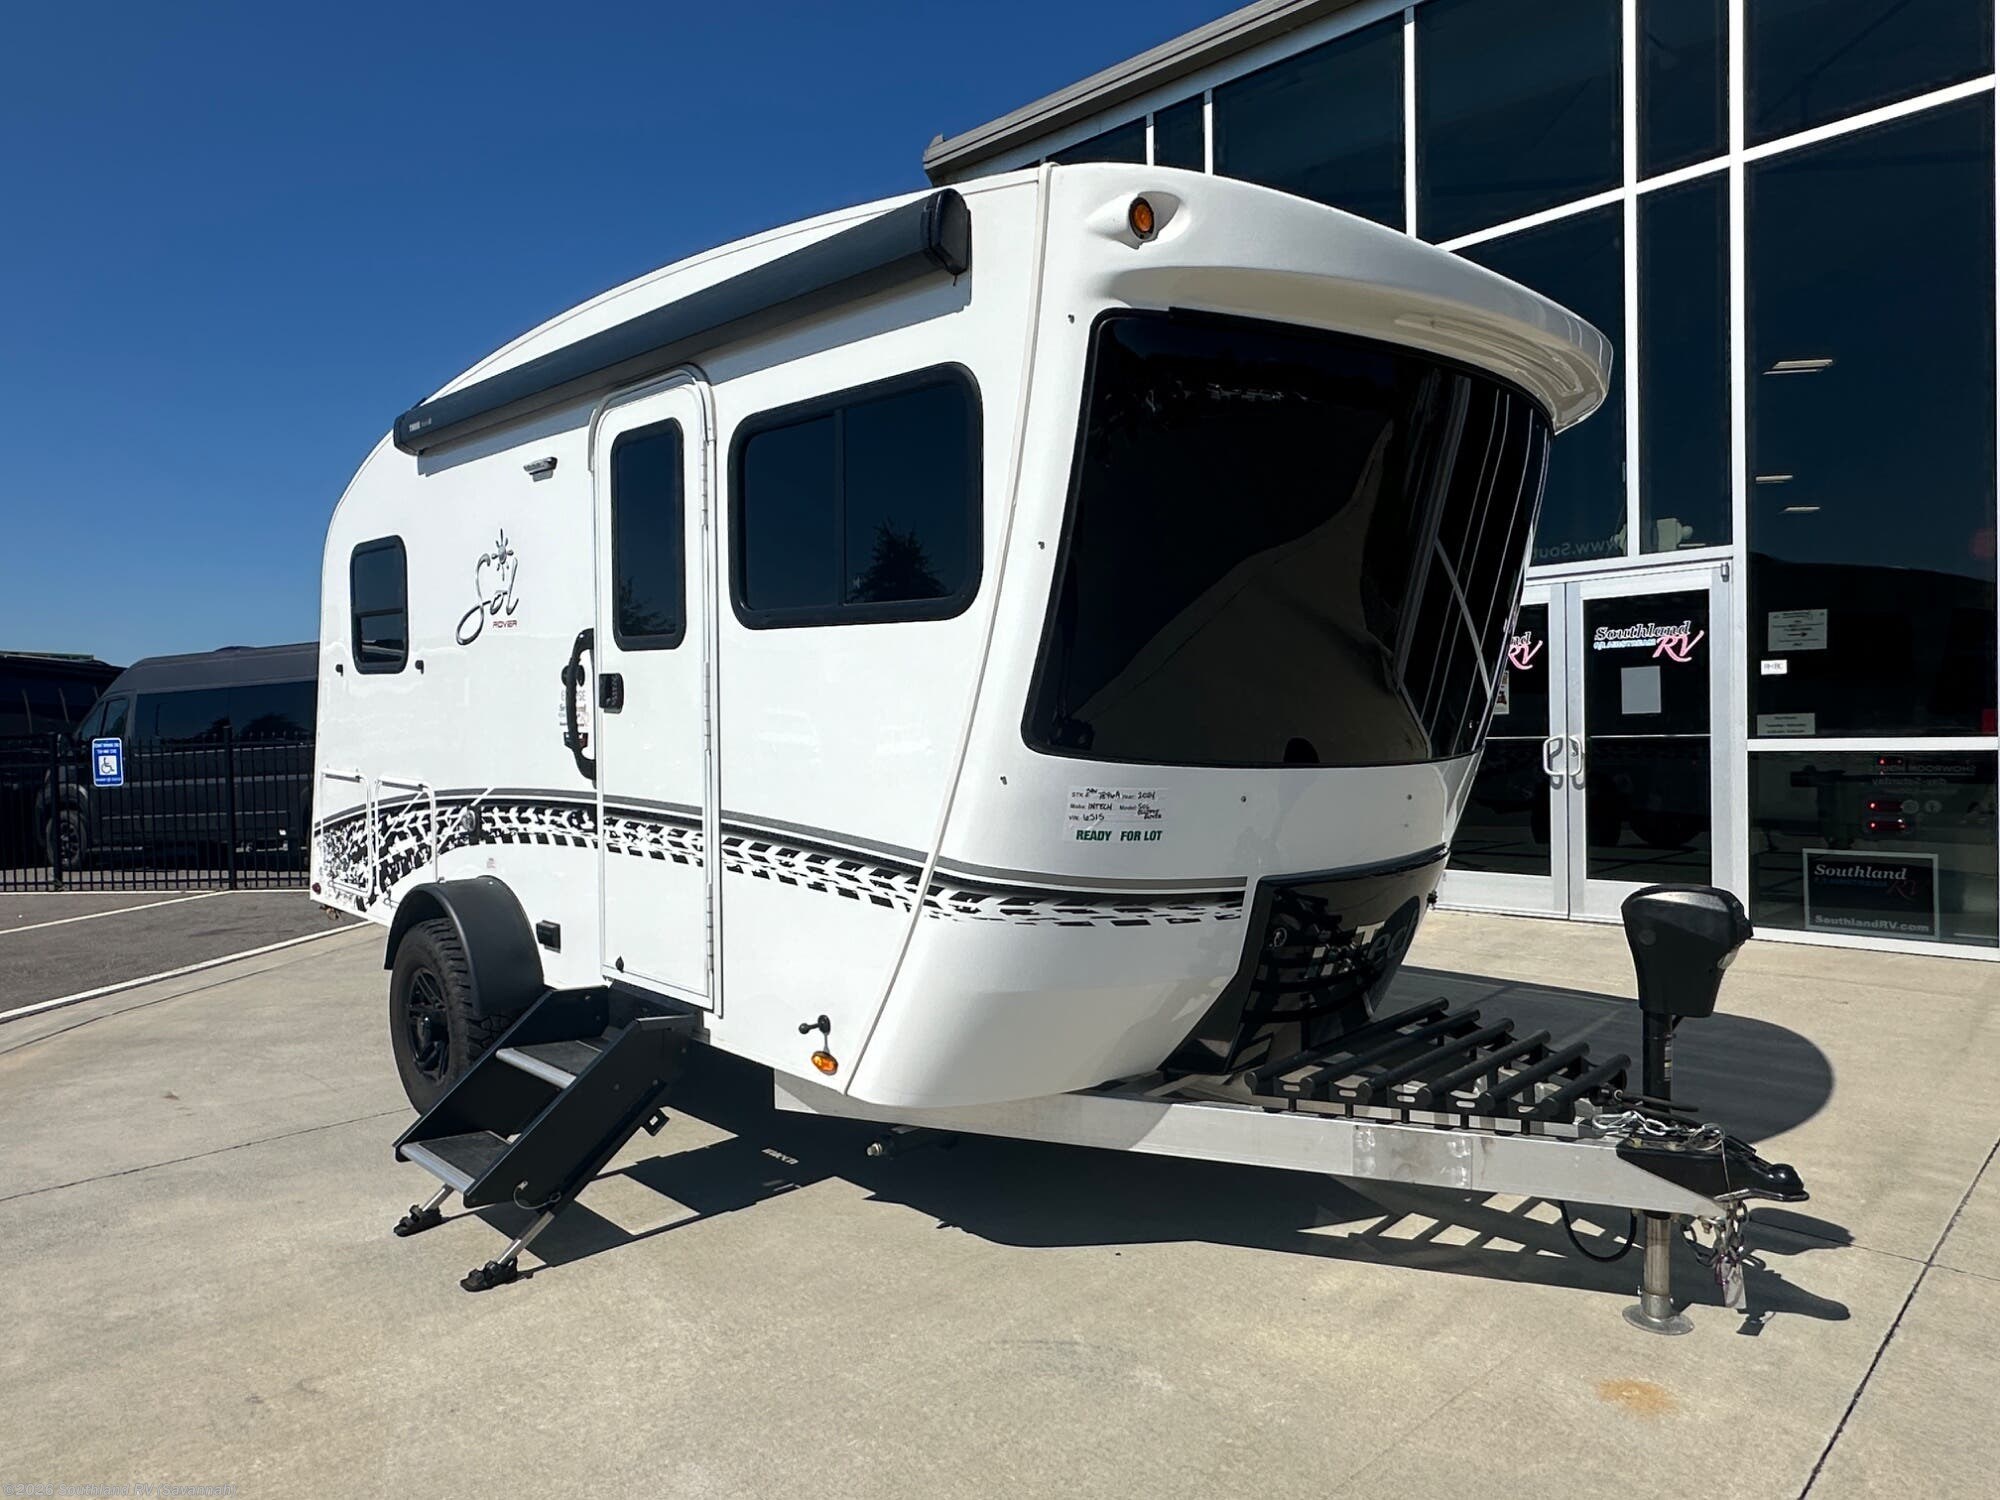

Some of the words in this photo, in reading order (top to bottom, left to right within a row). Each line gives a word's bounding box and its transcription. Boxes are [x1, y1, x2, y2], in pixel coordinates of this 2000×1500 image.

[1594, 620, 1692, 642] Southland
[1652, 630, 1705, 663] RV
[1076, 829, 1113, 841] READY
[1120, 830, 1141, 841] FOR
[1143, 830, 1163, 841] LOT
[1813, 863, 1909, 880] Southland
[1815, 914, 1930, 933] SouthlandRV.com
